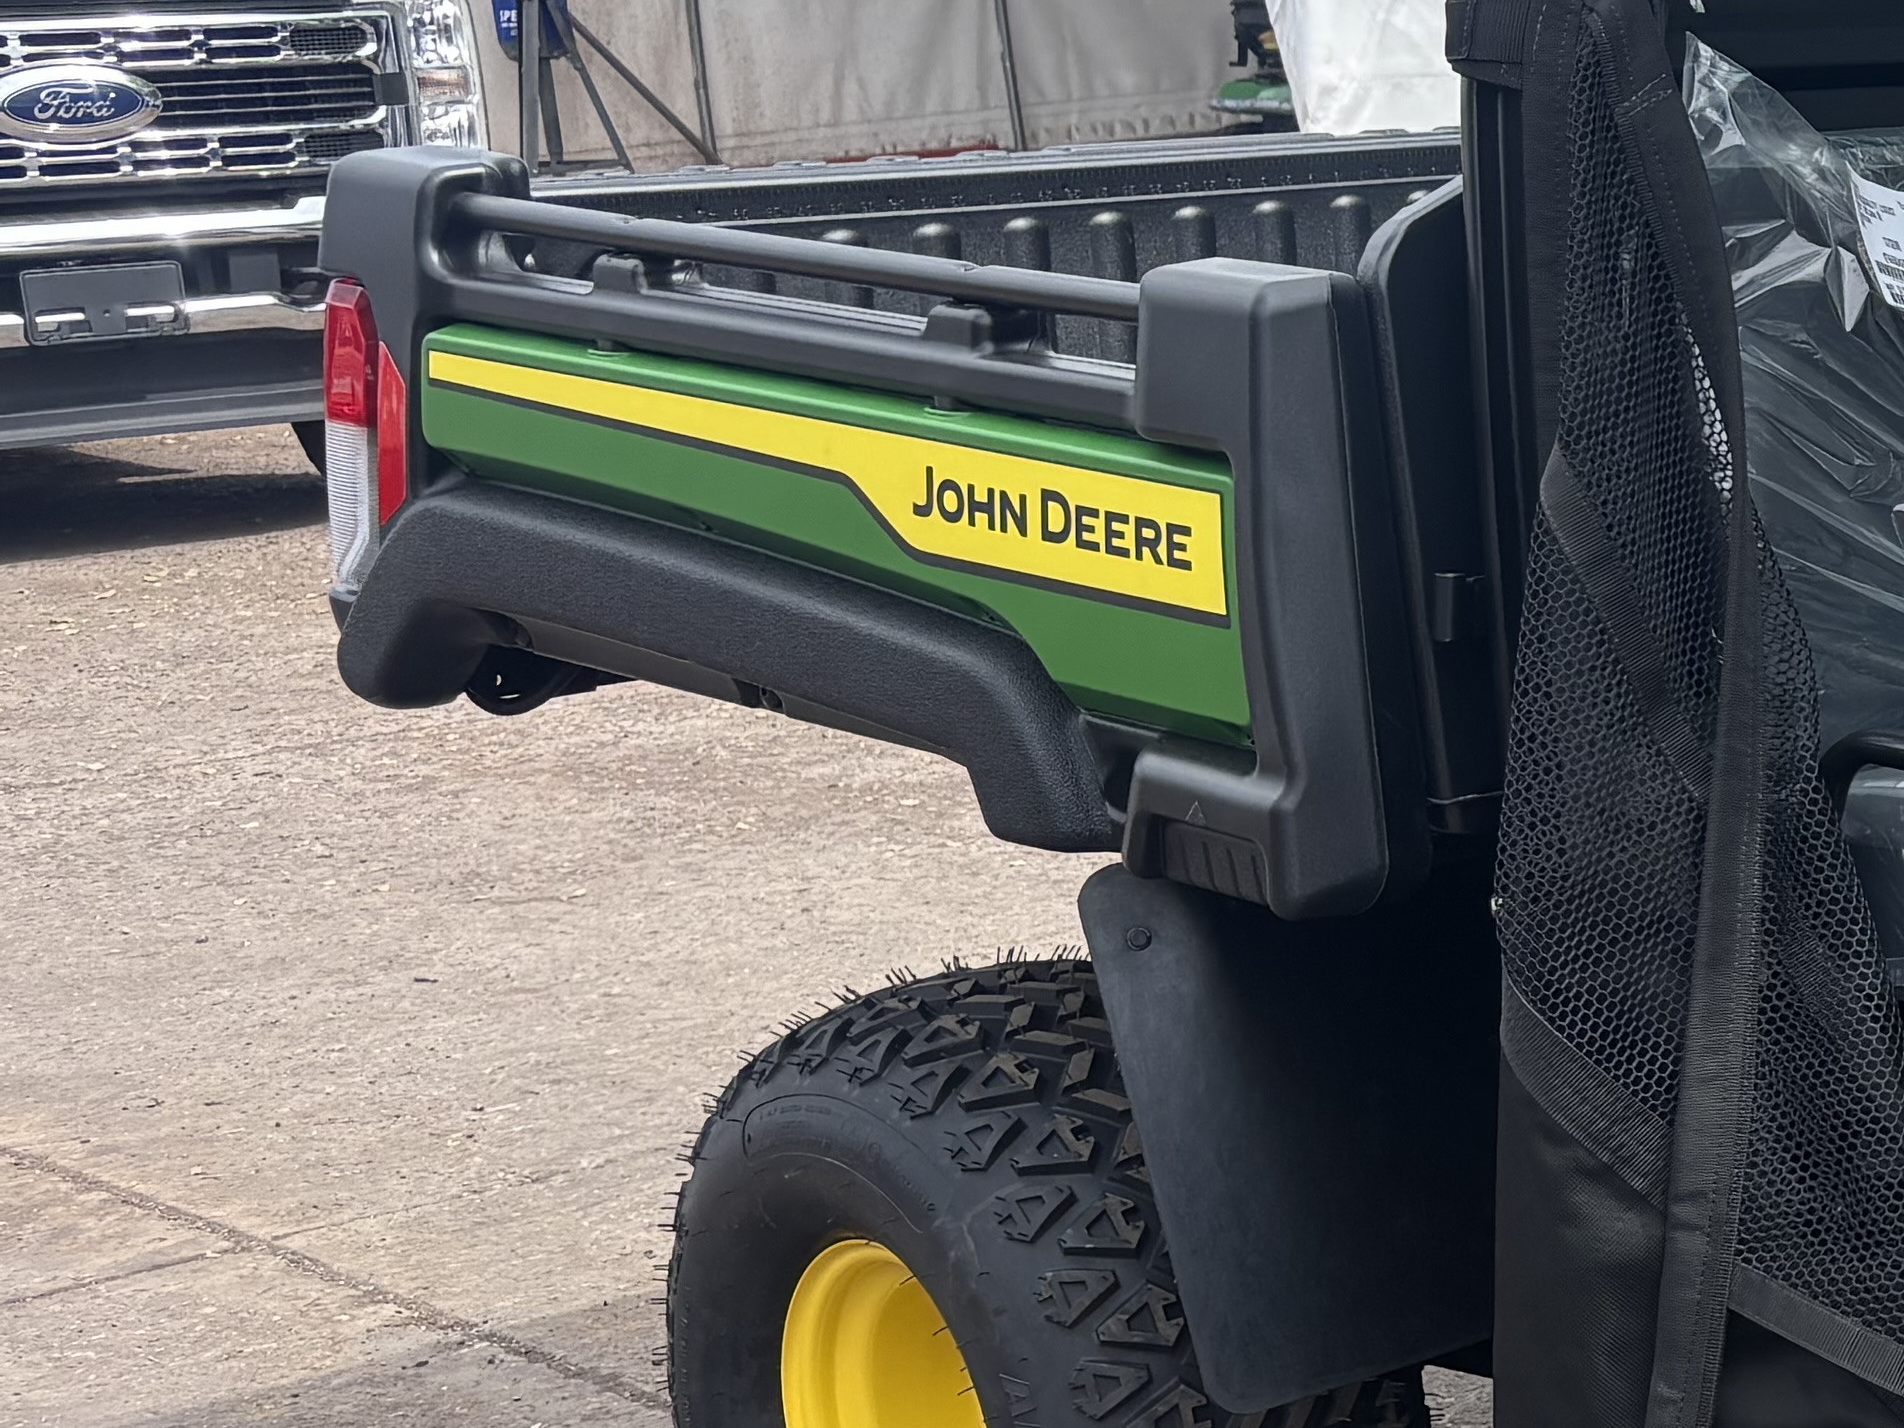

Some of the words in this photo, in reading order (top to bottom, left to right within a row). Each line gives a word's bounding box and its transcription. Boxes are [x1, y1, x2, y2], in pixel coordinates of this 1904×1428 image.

[33, 86, 117, 120] Ford
[912, 465, 1028, 539] JOHN
[1040, 488, 1193, 571] DEERE
